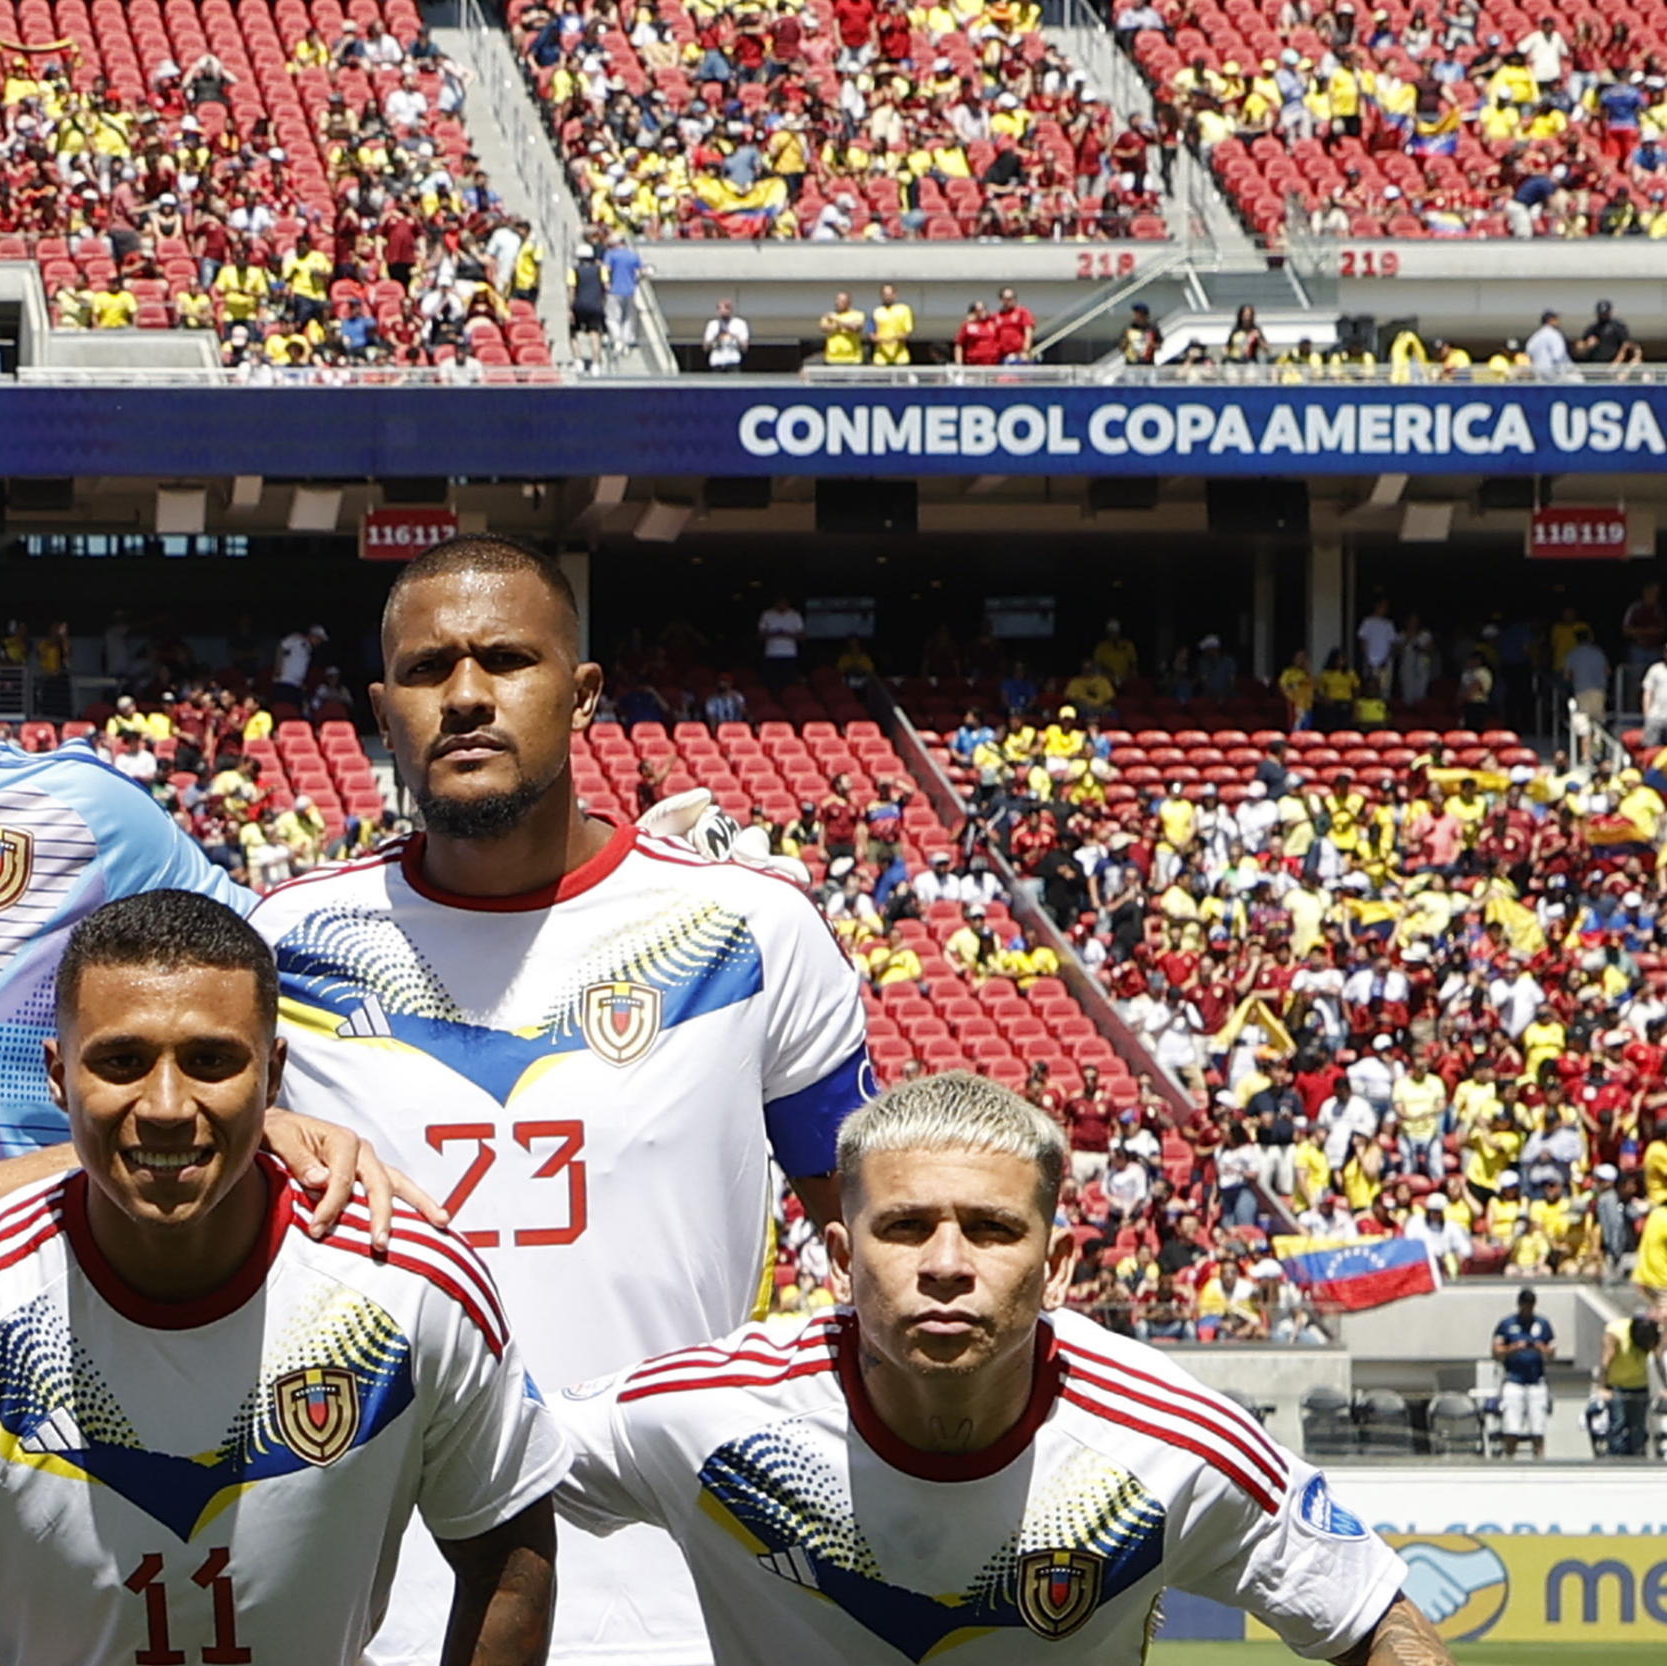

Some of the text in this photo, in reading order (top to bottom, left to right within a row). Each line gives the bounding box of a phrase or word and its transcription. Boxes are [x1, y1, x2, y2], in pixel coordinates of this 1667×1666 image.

[1078, 252, 1135, 278] 218
[1340, 250, 1399, 277] 219
[739, 401, 1666, 456] CONMEBOL COPA AMERICA USA
[368, 525, 411, 546] 116
[1534, 522, 1625, 545] 118 119
[423, 1118, 589, 1248] 23
[122, 1545, 253, 1666] 11
